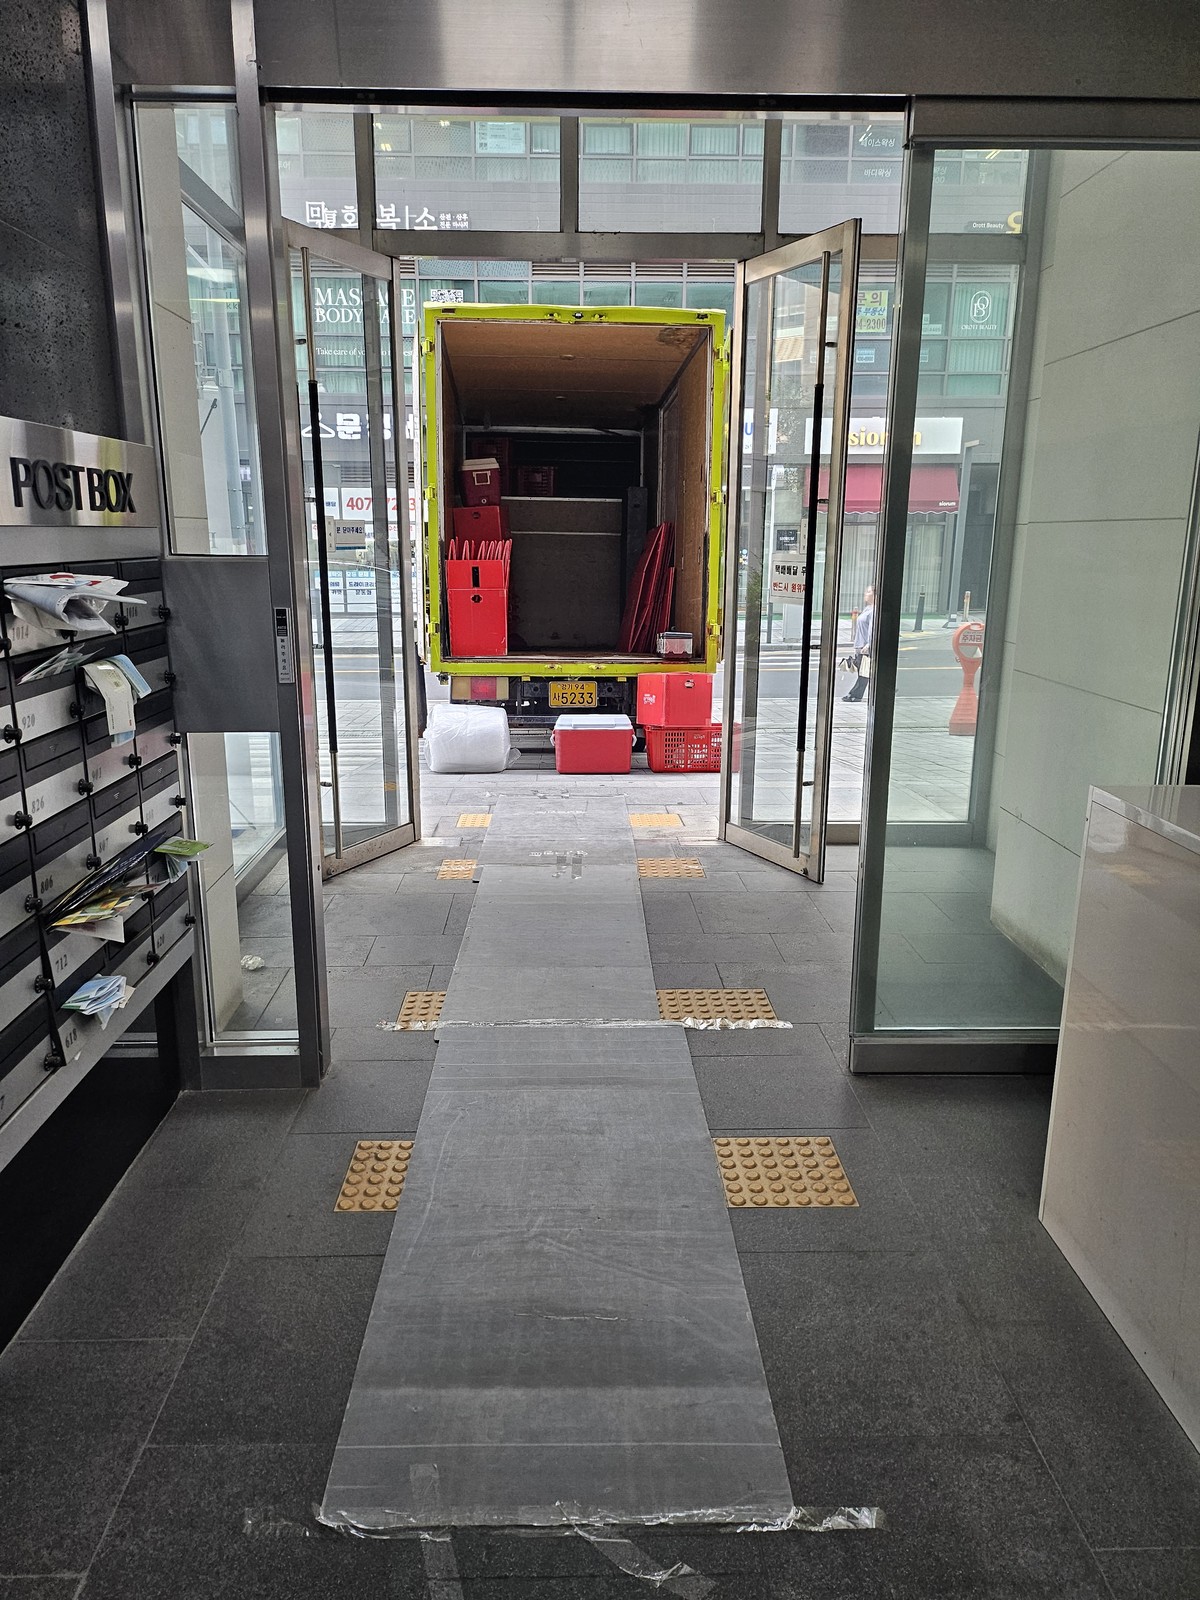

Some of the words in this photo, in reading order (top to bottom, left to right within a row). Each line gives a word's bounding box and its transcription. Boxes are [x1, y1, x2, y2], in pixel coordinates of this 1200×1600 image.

[314, 307, 363, 324] BODY
[315, 347, 333, 356] Take
[12, 625, 29, 641] 1014
[574, 683, 585, 691] 94
[21, 713, 36, 731] 920
[31, 795, 45, 814] 826
[40, 874, 54, 895] 806
[55, 953, 68, 974] 712
[65, 1028, 78, 1049] 618
